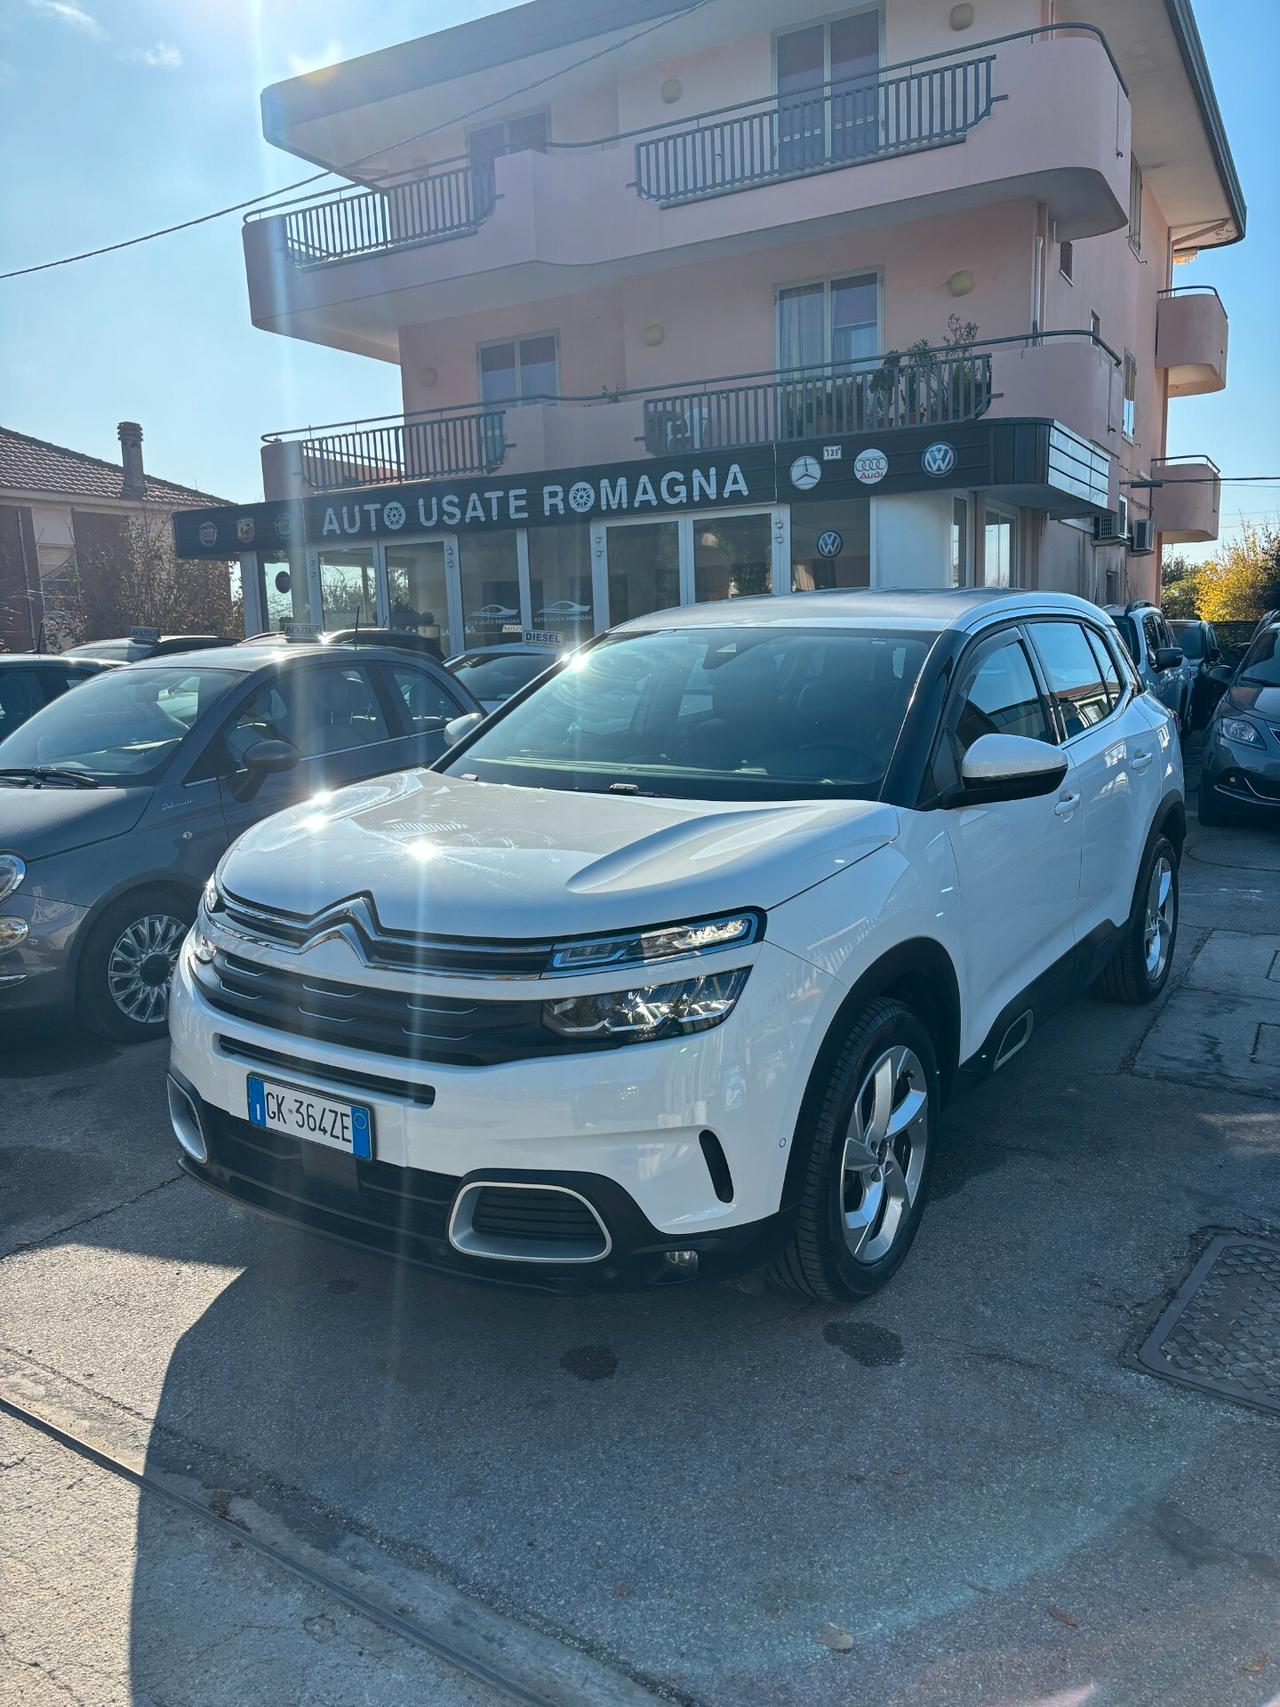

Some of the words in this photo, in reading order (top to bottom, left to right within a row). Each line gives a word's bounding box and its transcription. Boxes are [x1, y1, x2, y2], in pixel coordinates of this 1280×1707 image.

[860, 471, 884, 480] Audi
[322, 501, 406, 536] AUTO
[418, 488, 528, 527] USATE
[542, 463, 749, 516] ROMAGNA
[526, 632, 560, 643] DIESEL
